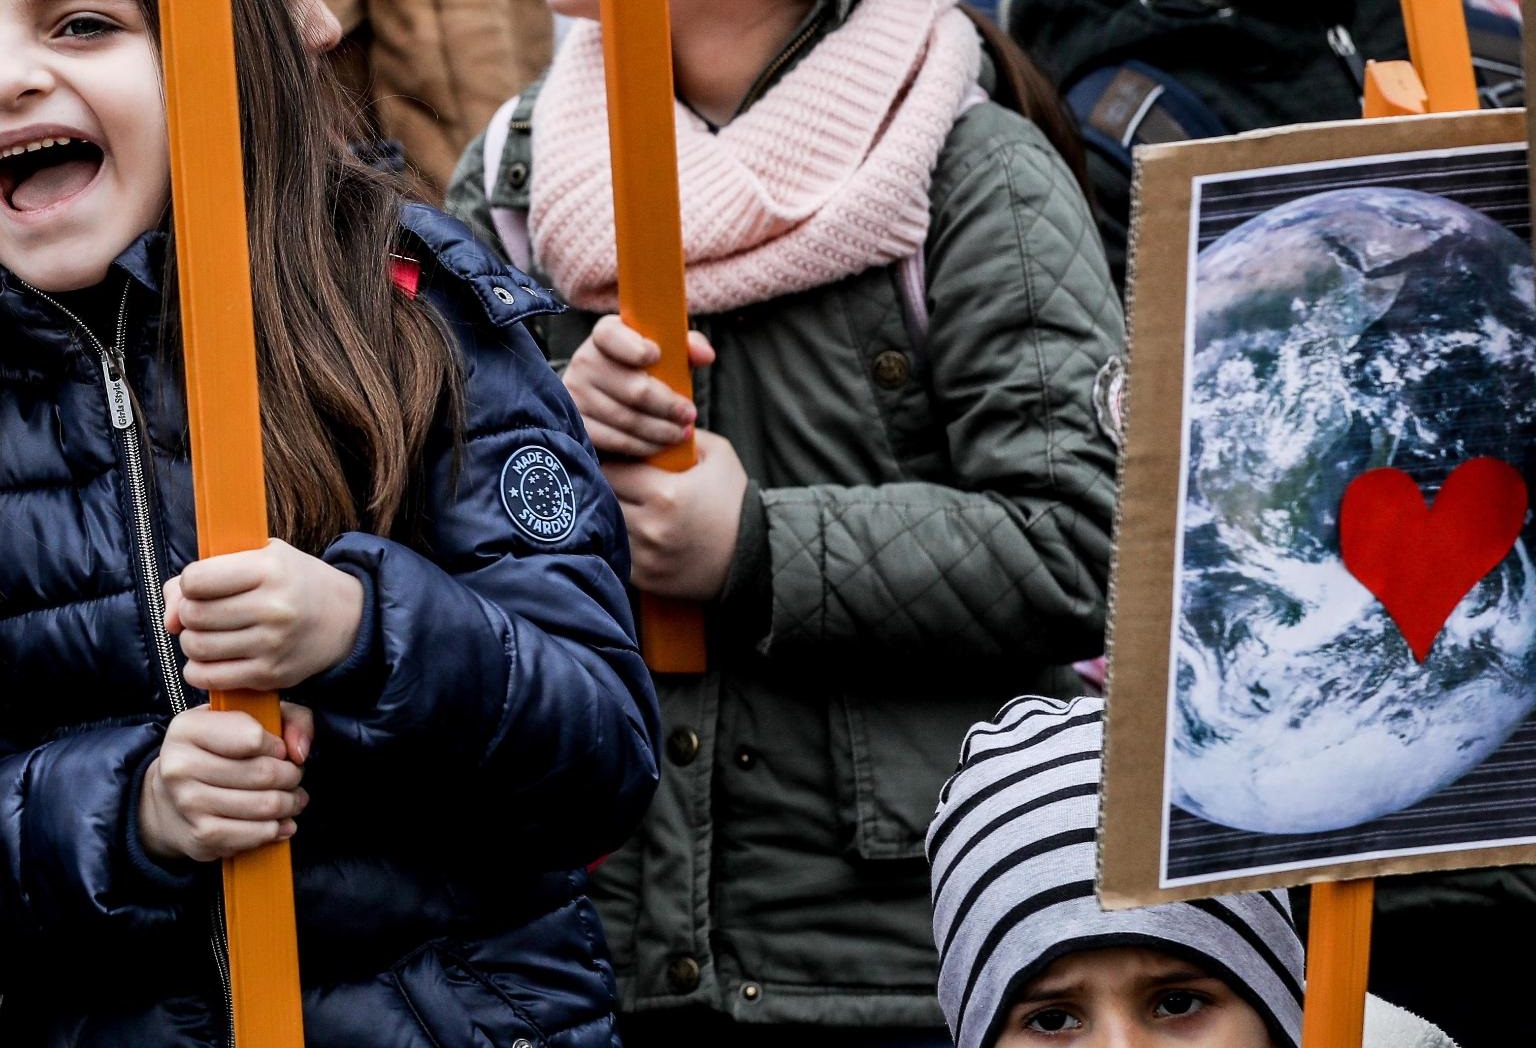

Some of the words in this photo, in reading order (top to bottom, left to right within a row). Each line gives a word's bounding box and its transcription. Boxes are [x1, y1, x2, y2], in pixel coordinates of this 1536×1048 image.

[113, 383, 124, 403] Style
[512, 452, 544, 475] MADE
[545, 456, 560, 471] OF
[518, 501, 573, 534] STARDUST
